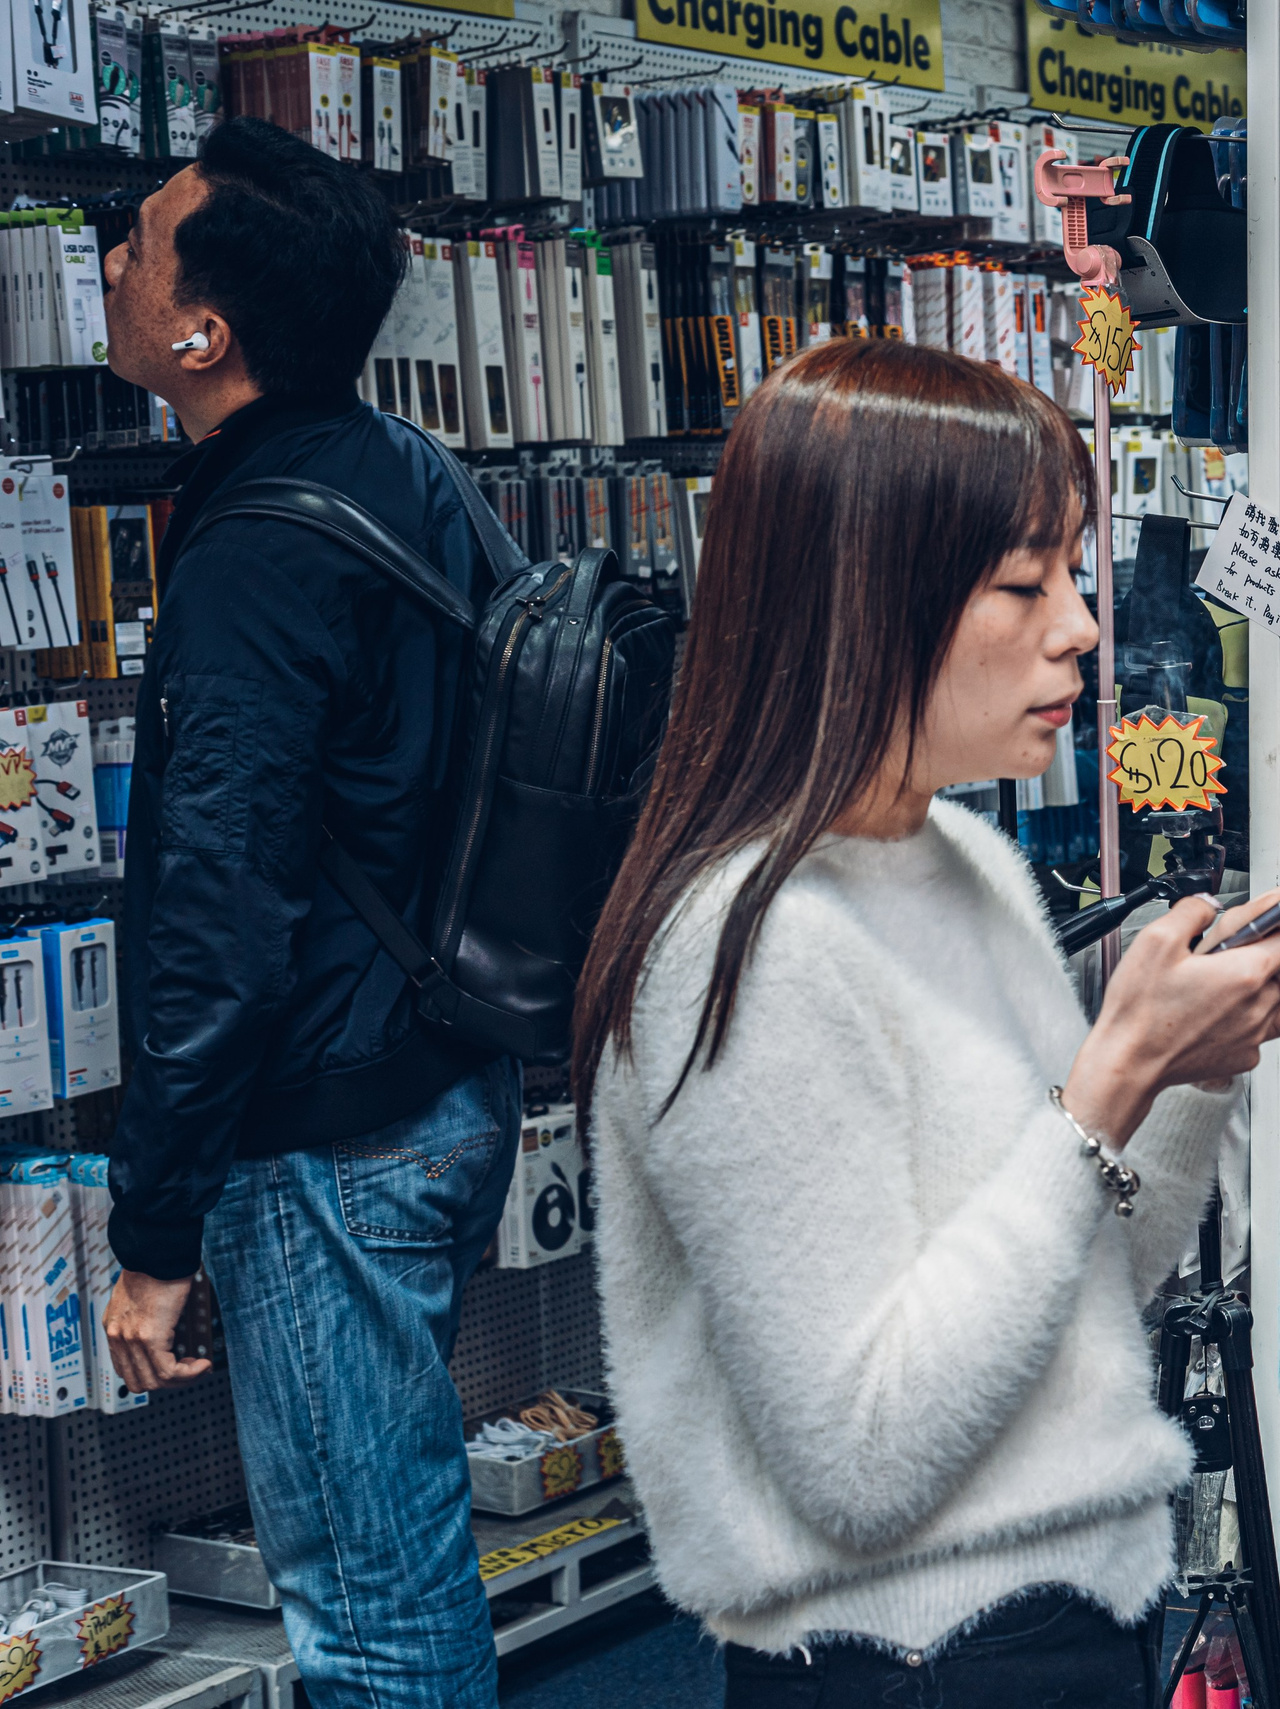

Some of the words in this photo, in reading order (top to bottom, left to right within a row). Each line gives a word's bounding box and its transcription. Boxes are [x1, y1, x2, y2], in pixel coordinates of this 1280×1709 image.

[834, 6, 931, 71] Cable
[1038, 46, 1165, 122] Charging
[1174, 75, 1244, 123] Cable
[63, 244, 78, 253] USB
[1224, 562, 1238, 577] for
[1216, 579, 1240, 601] Break
[1262, 604, 1275, 626] Pay
[1119, 737, 1208, 794] $120
